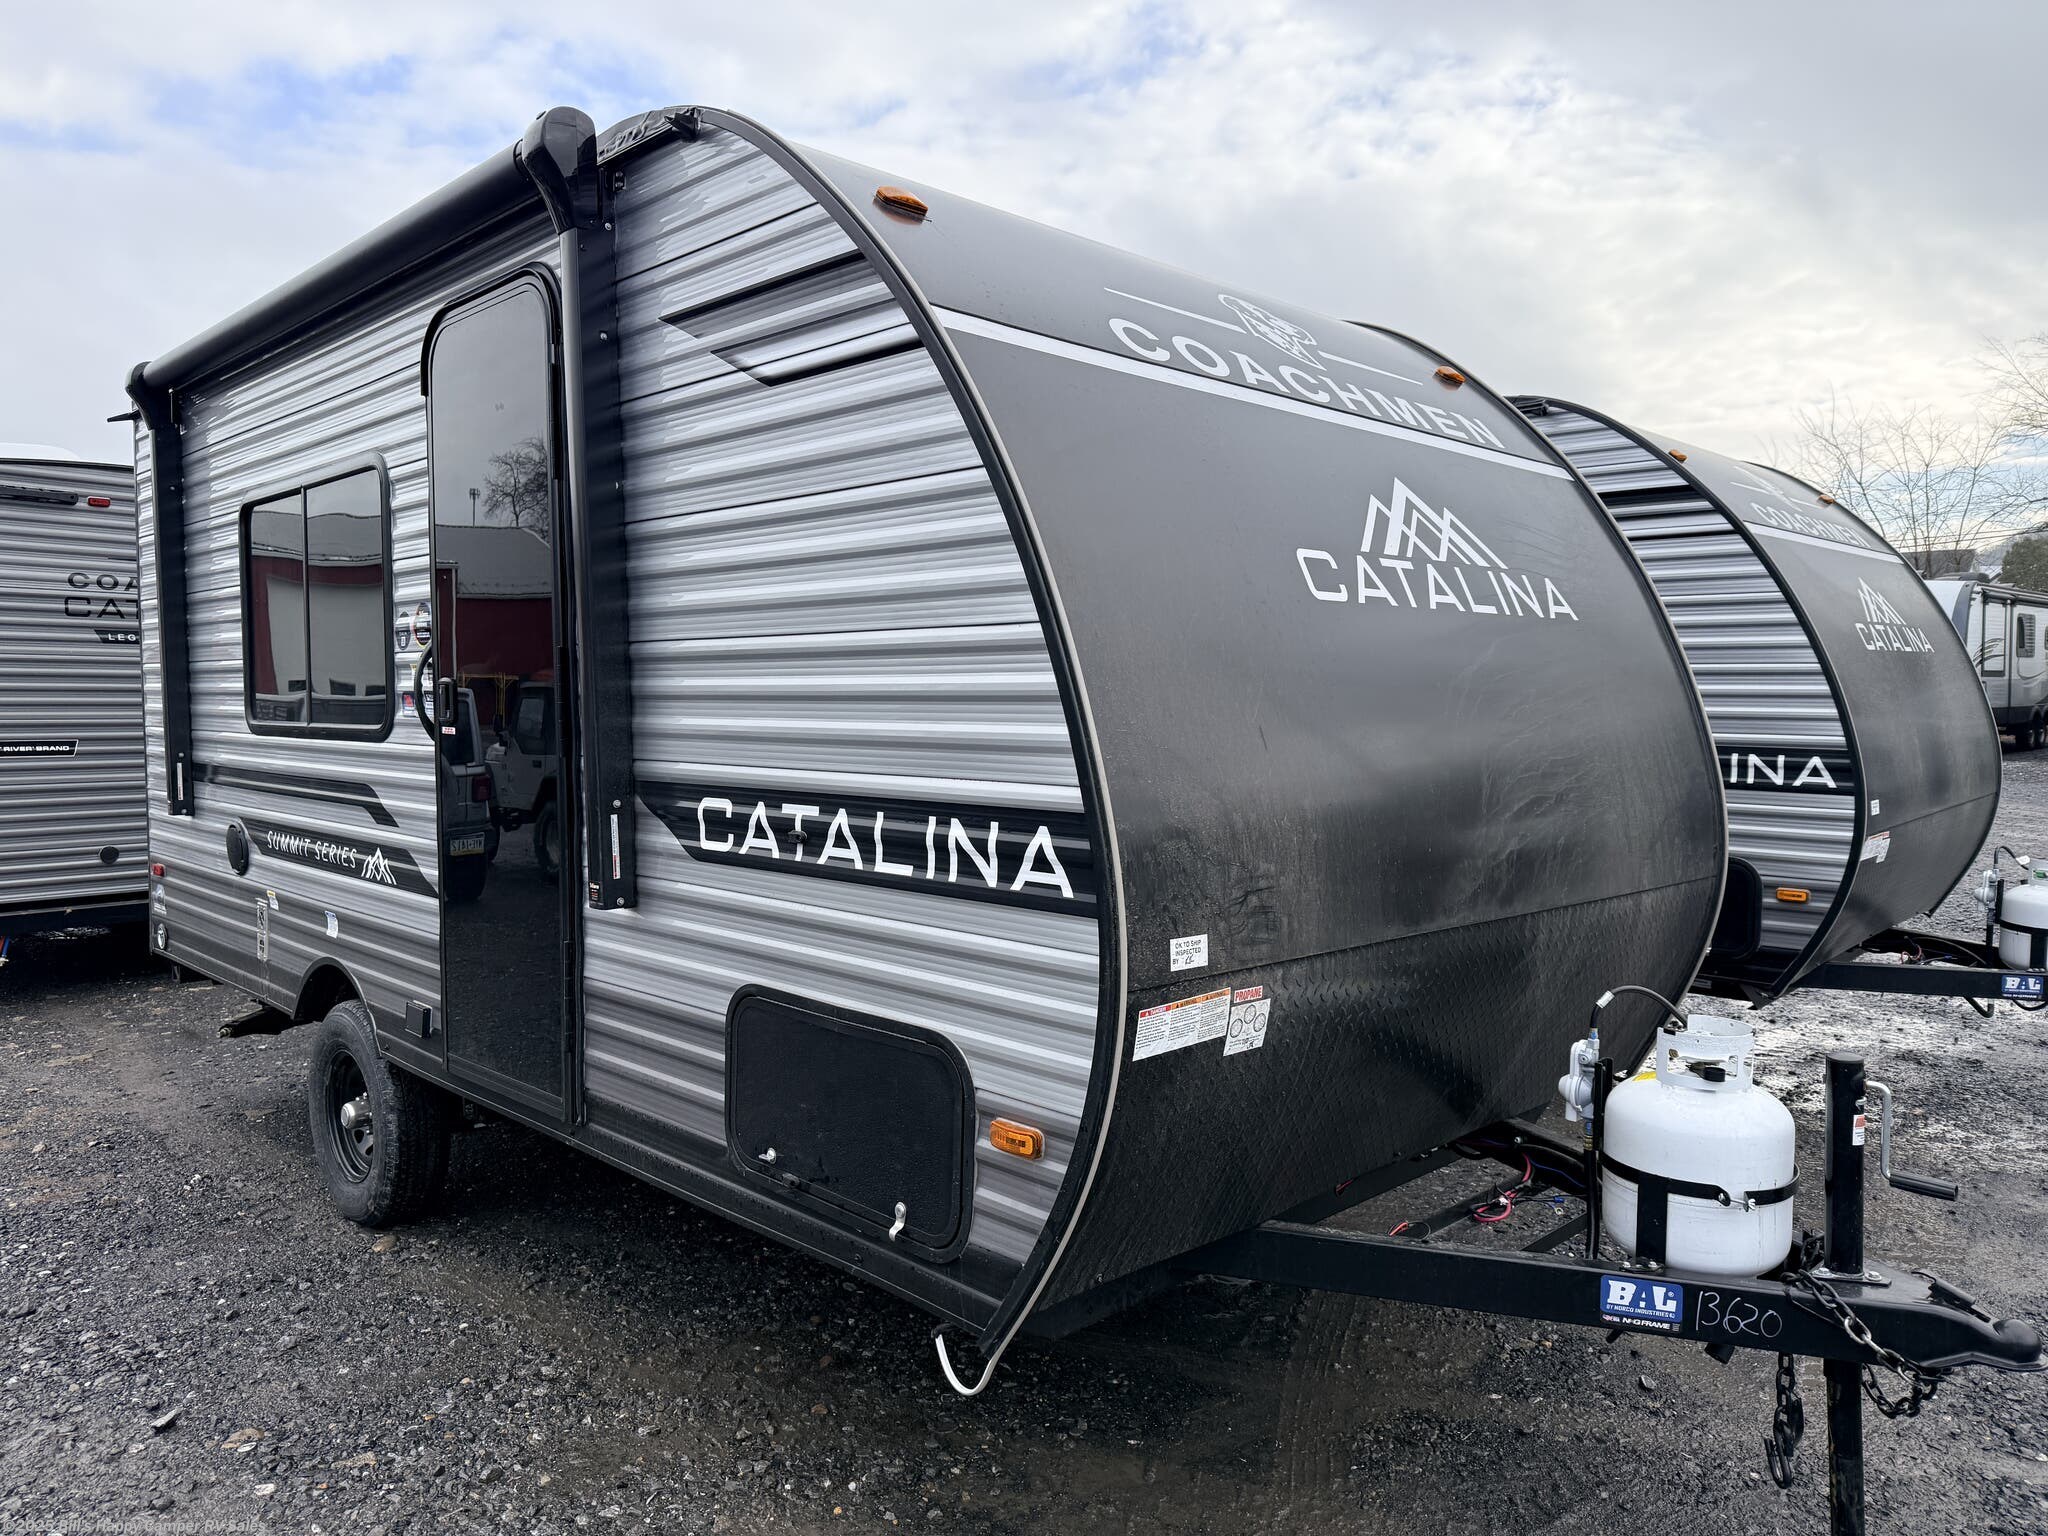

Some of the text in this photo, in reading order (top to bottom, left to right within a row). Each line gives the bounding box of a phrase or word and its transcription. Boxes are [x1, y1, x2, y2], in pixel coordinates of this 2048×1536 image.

[1108, 318, 1505, 449] COACHMEN
[1751, 502, 1872, 548] COACHMEN
[1296, 547, 1579, 621] CATALINA
[1855, 622, 1936, 653] CATALINA
[1729, 752, 1838, 789] INA
[267, 830, 358, 869] SUMMIT SERIES
[697, 796, 1075, 899] CATALINA
[1174, 946, 1202, 957] INSPECTED
[1234, 986, 1262, 1002] PROPANE
[2005, 976, 2041, 990] BAL
[1635, 1308, 1668, 1318] INDUSTRIES
[1641, 1320, 1671, 1330] FRAME
[1695, 1290, 1783, 1338] 13620
